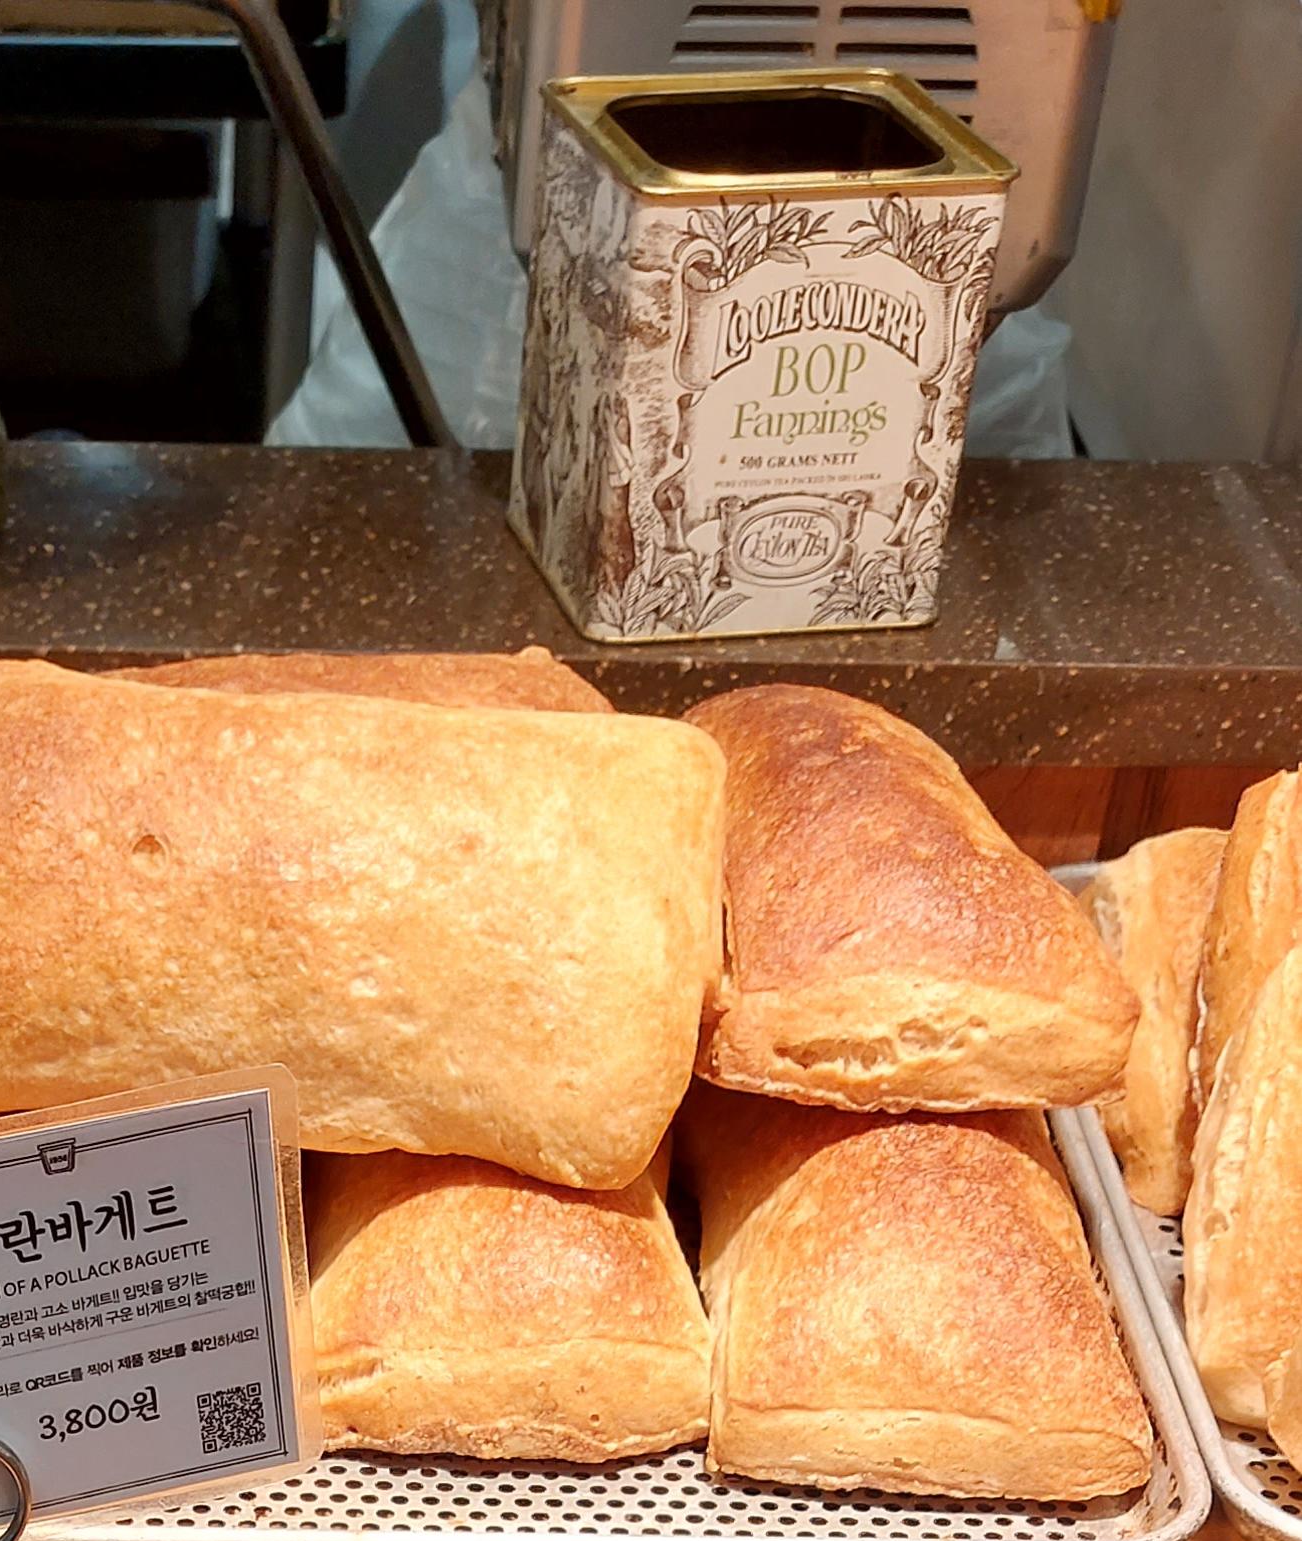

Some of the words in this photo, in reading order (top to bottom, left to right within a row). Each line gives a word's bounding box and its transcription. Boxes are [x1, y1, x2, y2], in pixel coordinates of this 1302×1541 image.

[711, 280, 927, 380] LOOLECONDERA
[771, 341, 867, 398] BOP
[730, 400, 887, 447] Fannings
[739, 455, 764, 470] 500
[766, 453, 818, 469] GRAMS
[821, 451, 859, 466] NETT
[769, 515, 819, 530] PURE
[3, 1279, 27, 1298] OF
[29, 1276, 44, 1292] A
[44, 1257, 121, 1290] POLLACK
[123, 1238, 211, 1271] BAGUETTE
[41, 1301, 70, 1320] 고소
[71, 1289, 120, 1312] 바게트!!
[122, 1279, 165, 1305] 입맛을
[166, 1271, 209, 1295] 당기는
[17, 1325, 46, 1344] 더욱
[47, 1313, 104, 1337] 바삭하게
[105, 1306, 135, 1326] 구운
[136, 1293, 192, 1318] 바게트의
[193, 1279, 257, 1308] 찰떡궁합!!
[24, 1366, 84, 1391] QR코드를
[86, 1360, 115, 1378] 찍어
[117, 1353, 145, 1372] 제품
[147, 1342, 188, 1365] 정보를
[189, 1326, 260, 1355] 확인하세요!
[39, 1387, 162, 1442] 3,800원
